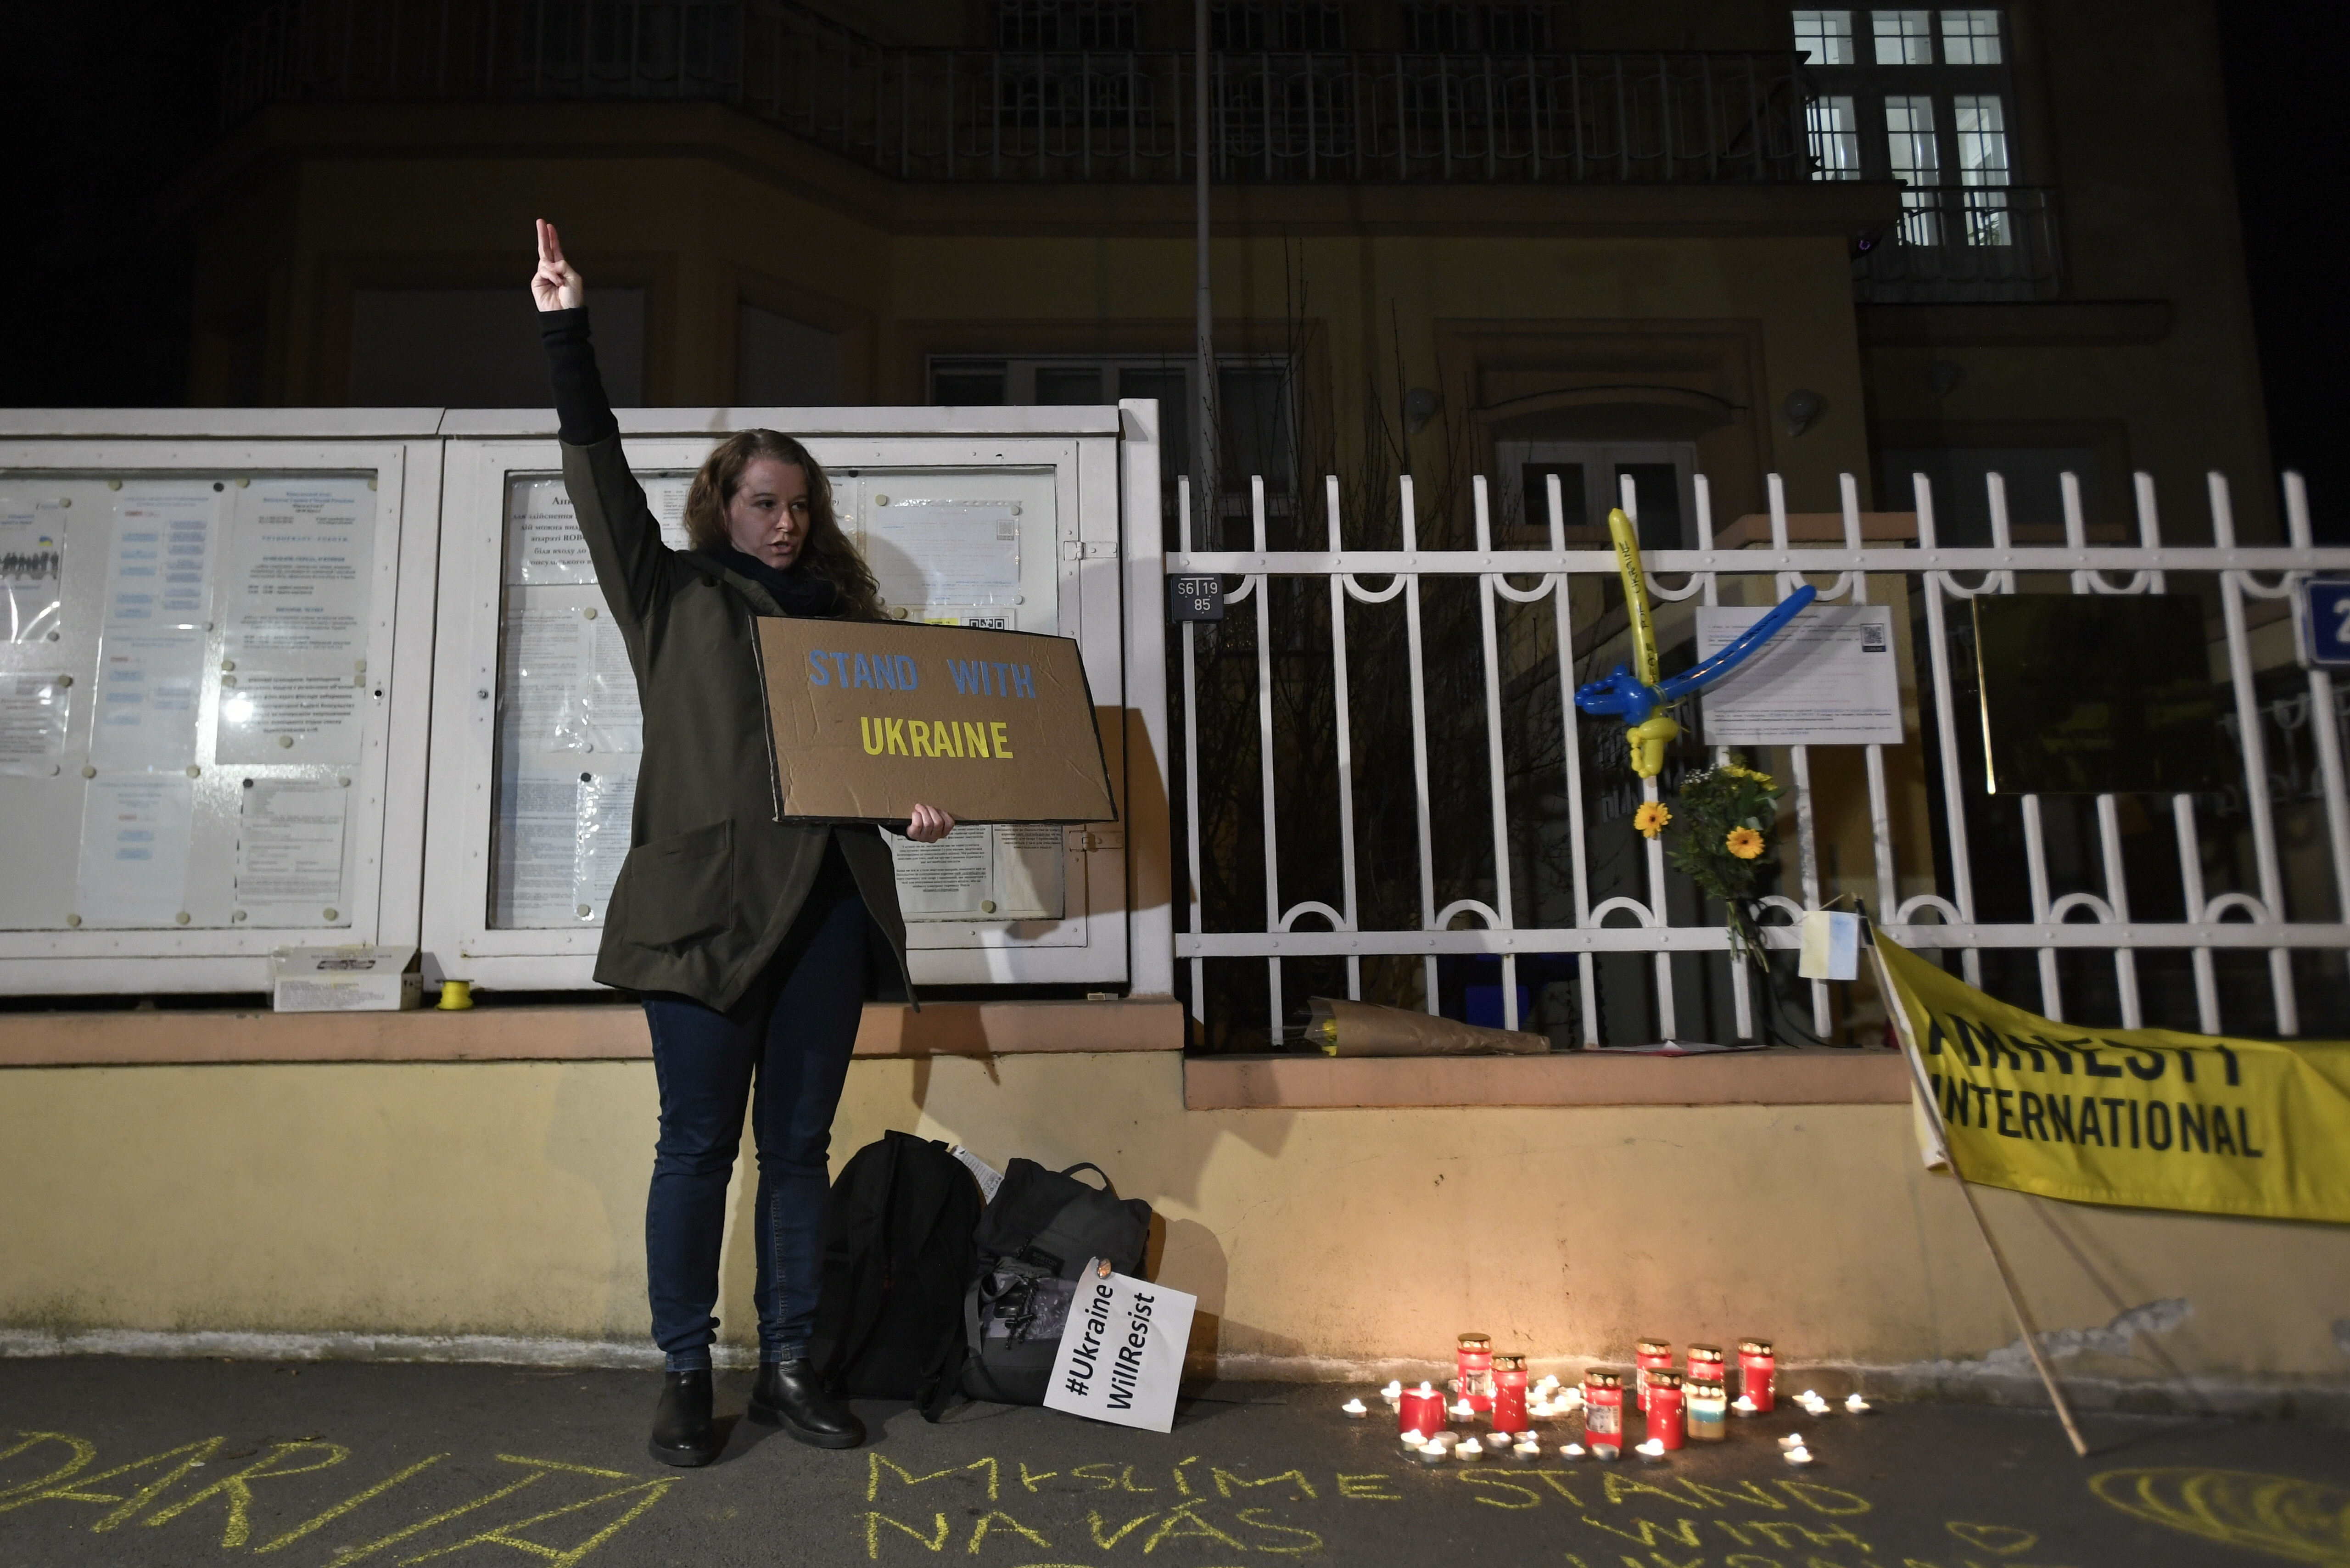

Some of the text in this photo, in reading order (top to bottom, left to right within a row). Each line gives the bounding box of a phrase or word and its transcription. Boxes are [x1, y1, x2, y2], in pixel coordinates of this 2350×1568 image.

[1194, 599, 1210, 610] 85
[1203, 582, 1218, 594] 19
[809, 650, 1036, 699] STAND WITH
[861, 716, 1013, 759] UKRAINE
[1930, 1073, 2263, 1158] INTERNATIONAL
[1065, 1284, 1113, 1396] #Ukraine
[1107, 1292, 1155, 1410] WillResist
[1456, 1468, 1873, 1516] STAND
[864, 1510, 1052, 1560] NA
[1581, 1514, 1874, 1555] WITH
